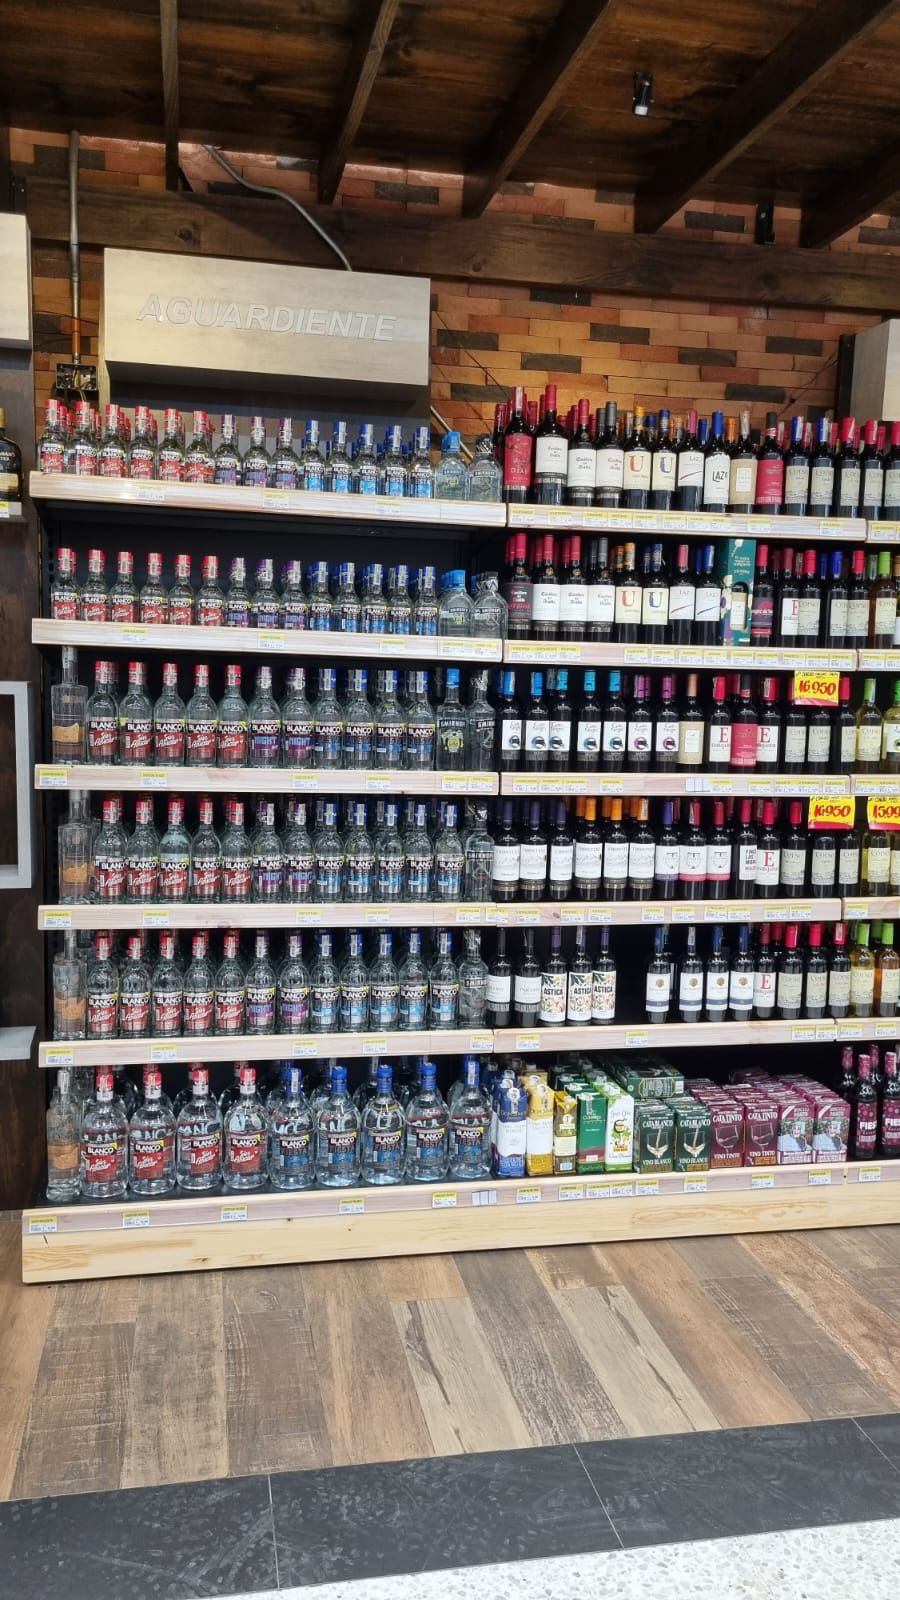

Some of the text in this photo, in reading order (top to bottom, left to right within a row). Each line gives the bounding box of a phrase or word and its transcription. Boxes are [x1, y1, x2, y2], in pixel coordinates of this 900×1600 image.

[136, 294, 398, 342] AGUARDIENTE
[629, 456, 644, 473] U
[660, 457, 674, 474] U
[621, 591, 637, 608] U
[648, 592, 664, 609] U
[91, 721, 117, 729] BLANCO
[156, 723, 182, 732] BLANCO
[188, 724, 215, 732] BLANCO
[252, 724, 279, 732] BLANCO
[286, 725, 311, 733] BLANCO
[315, 726, 342, 734] BLANCO
[346, 726, 372, 735] BLANCO
[378, 727, 403, 735] BLANCO
[408, 728, 433, 736] BLANCO
[720, 727, 730, 743] E
[760, 727, 771, 743] E
[764, 852, 775, 867] E
[760, 974, 771, 990] E
[433, 989, 458, 998] BLANCO
[544, 988, 564, 996] ASTICA
[574, 987, 591, 996] ASTIC
[594, 986, 614, 994] ASTICA
[247, 992, 274, 1001] BLANCO
[281, 992, 307, 1001] BLANCO
[315, 992, 340, 1000] BLANCO
[343, 991, 368, 1000] BLANCO
[372, 990, 398, 999] BLANCO
[402, 990, 428, 999] BLANCO
[89, 998, 116, 1006] BLANCO
[122, 997, 149, 1005] BLANCO
[157, 997, 183, 1005] BLANCO
[186, 997, 212, 1005] BLANCO
[218, 996, 244, 1004] BLANCO
[418, 1132, 443, 1140] BLANCO
[456, 1130, 481, 1138] BLANCO
[193, 1138, 218, 1147] BLANCO
[232, 1138, 258, 1146] BLANCO
[281, 1140, 307, 1148] BLANCO
[330, 1137, 355, 1146] BLANCO
[375, 1136, 401, 1144] BLANCO
[87, 1147, 114, 1155] BLANCO
[136, 1143, 161, 1152] BLANCO
